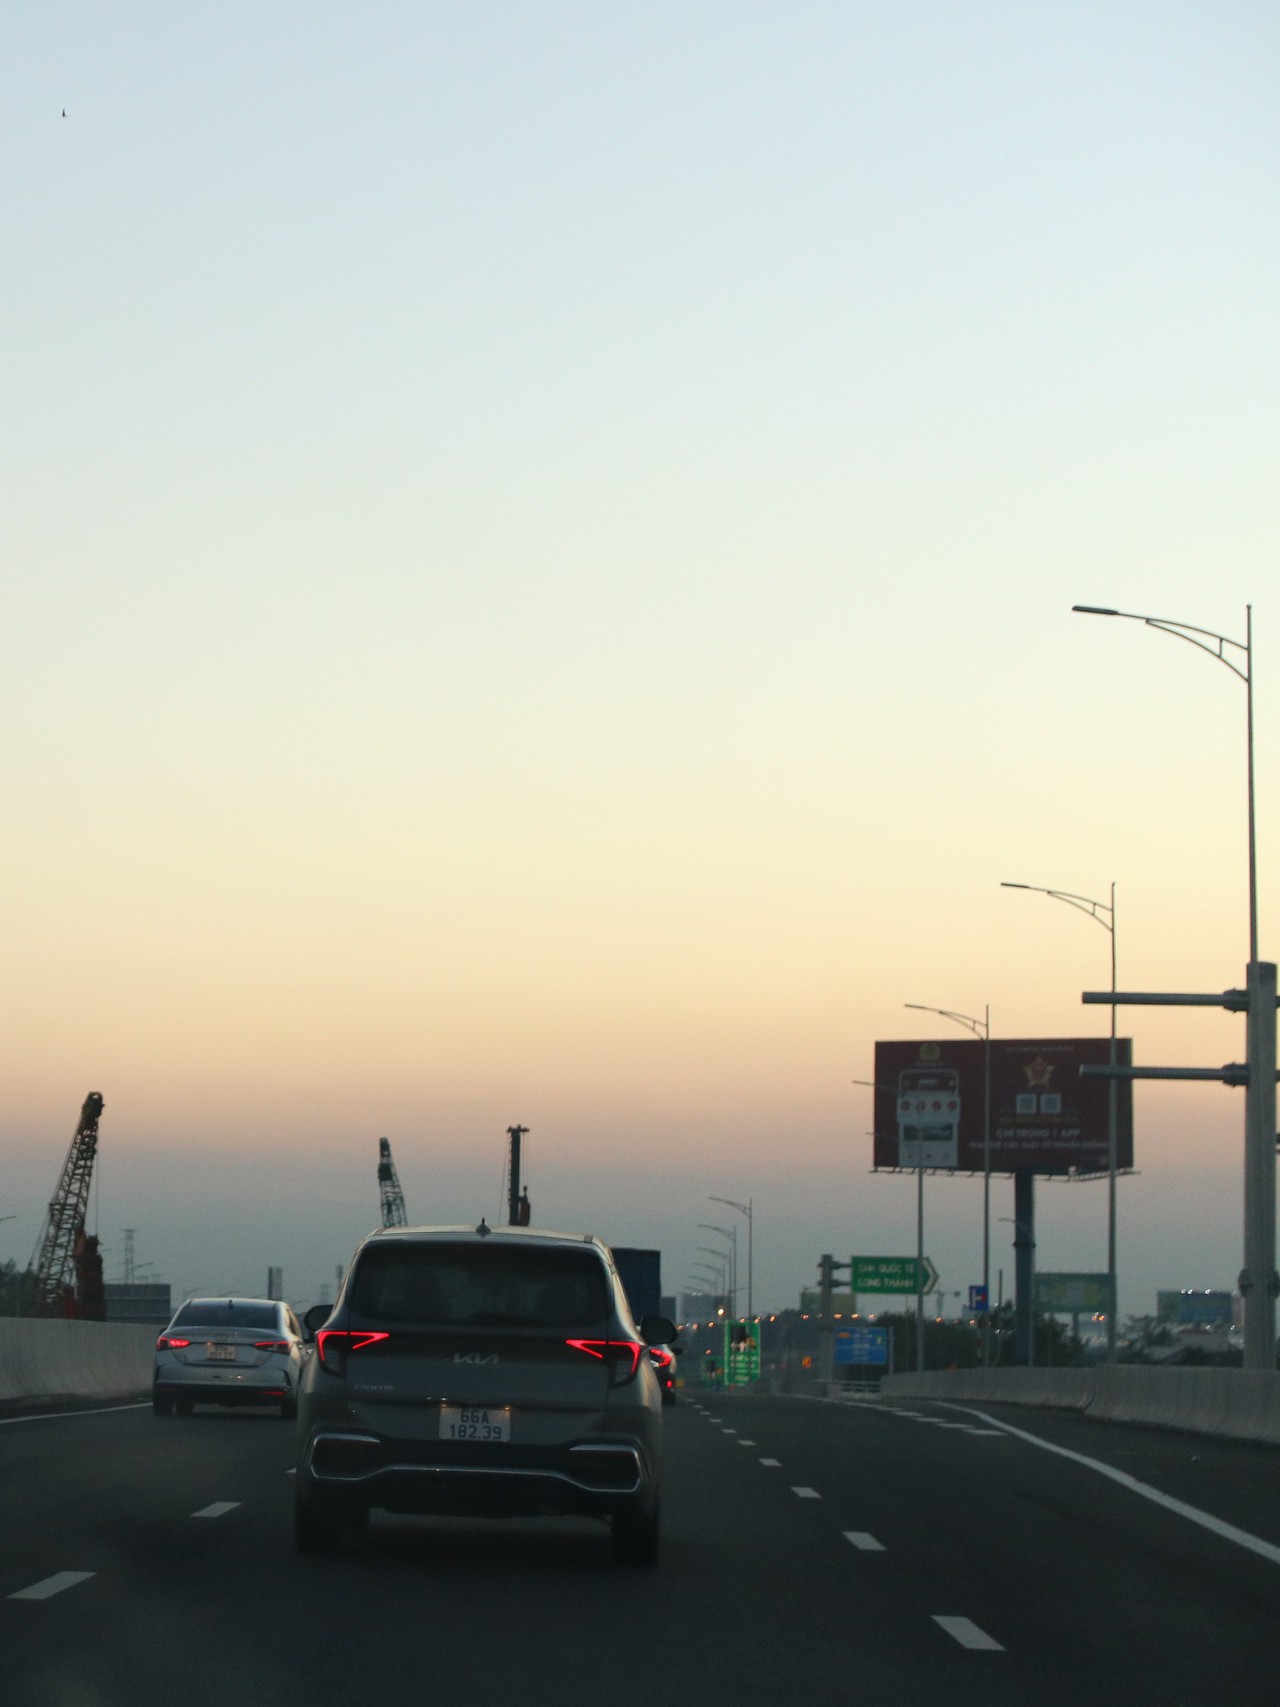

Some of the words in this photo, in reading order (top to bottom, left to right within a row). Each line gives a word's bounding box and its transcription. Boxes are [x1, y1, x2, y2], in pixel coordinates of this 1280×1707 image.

[452, 1352, 499, 1364] KIA
[460, 1410, 489, 1424] 66A
[450, 1423, 502, 1440] 182.39
